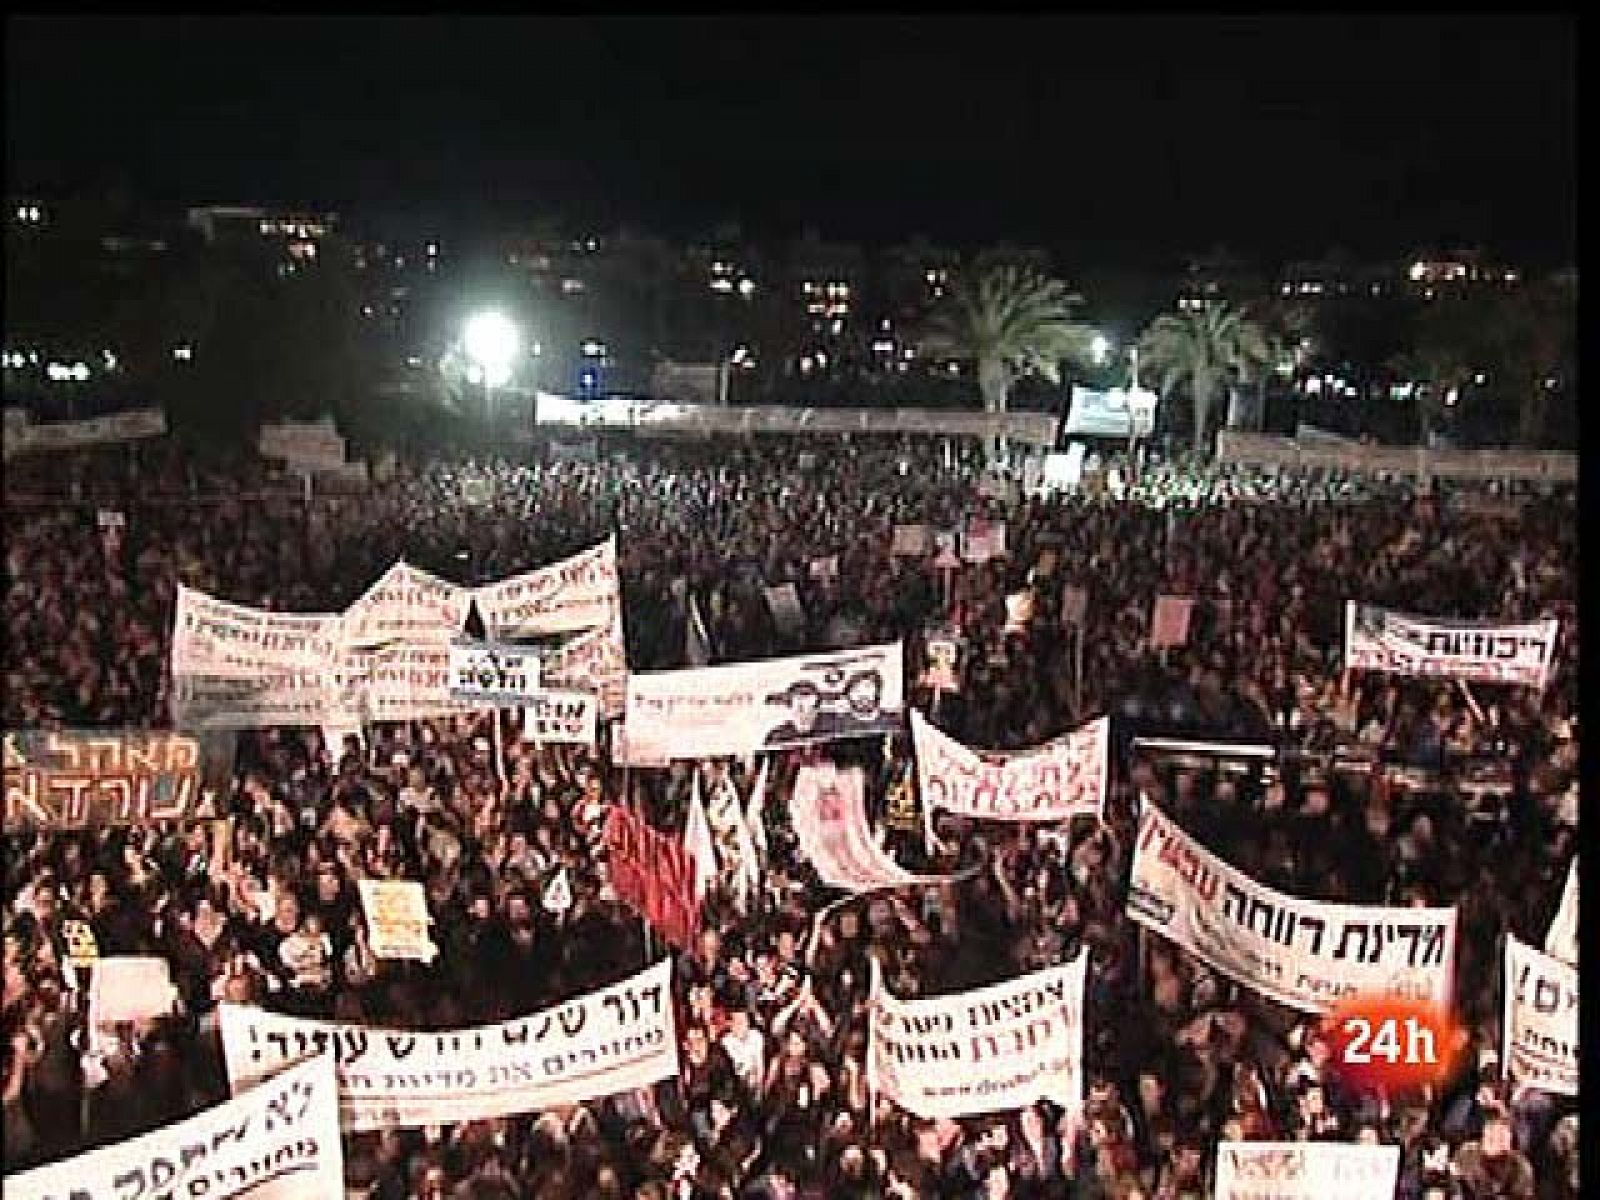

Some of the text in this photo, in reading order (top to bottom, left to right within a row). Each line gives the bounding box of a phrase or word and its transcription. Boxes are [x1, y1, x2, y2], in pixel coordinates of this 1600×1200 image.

[49, 733, 198, 771] מאהל
[1225, 882, 1325, 955] רווחה
[1332, 924, 1446, 966] מדינת
[602, 983, 662, 1025] דור
